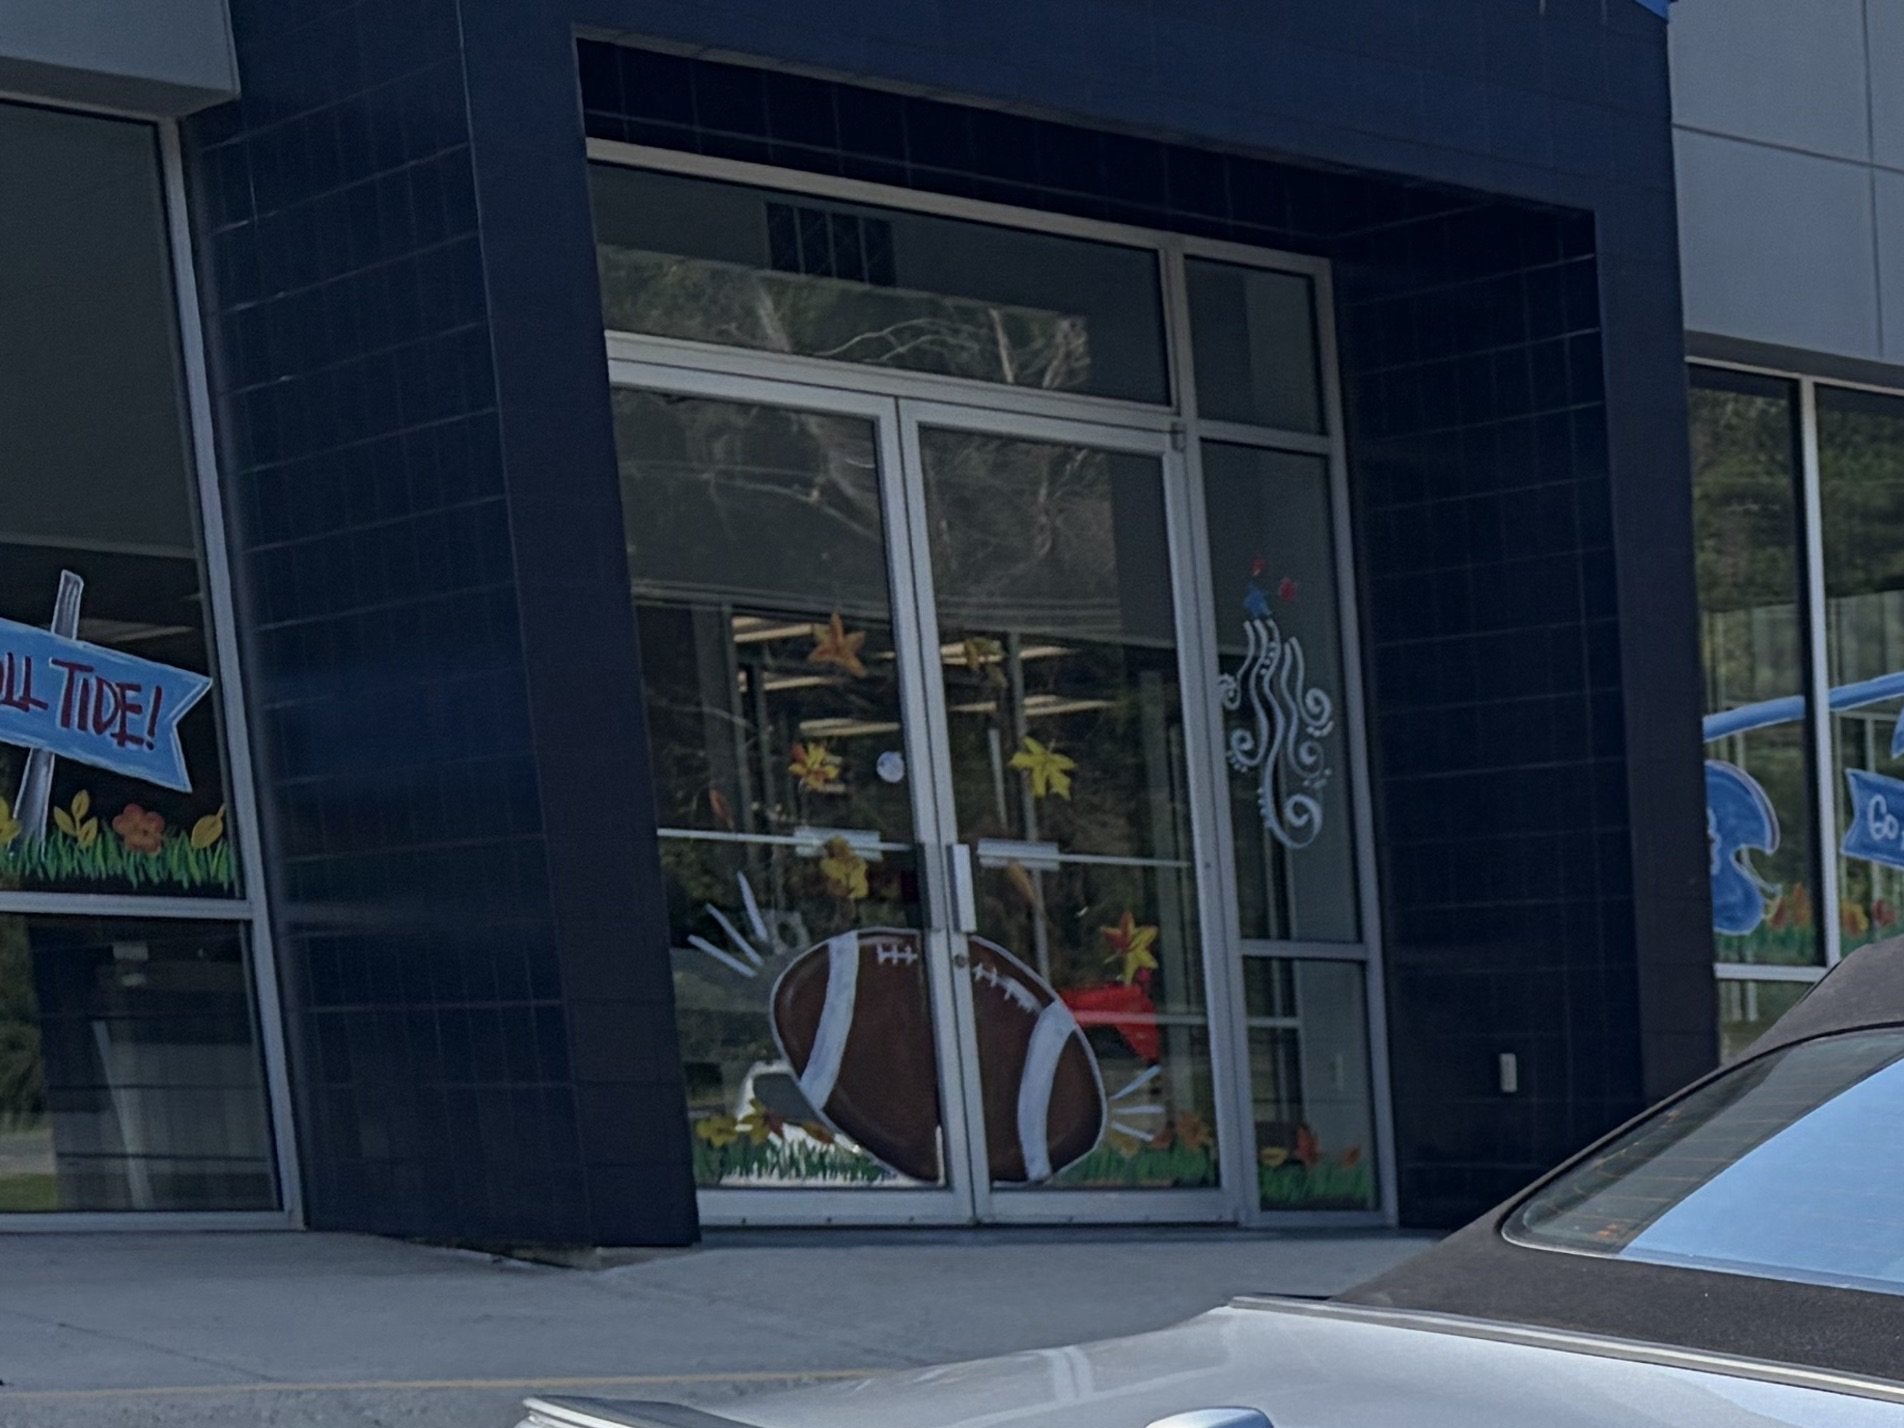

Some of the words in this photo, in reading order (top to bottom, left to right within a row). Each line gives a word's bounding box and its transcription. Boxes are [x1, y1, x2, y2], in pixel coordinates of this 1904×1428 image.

[0, 652, 49, 712] LL
[50, 658, 162, 751] TIDE!
[1867, 794, 1900, 842] Go
